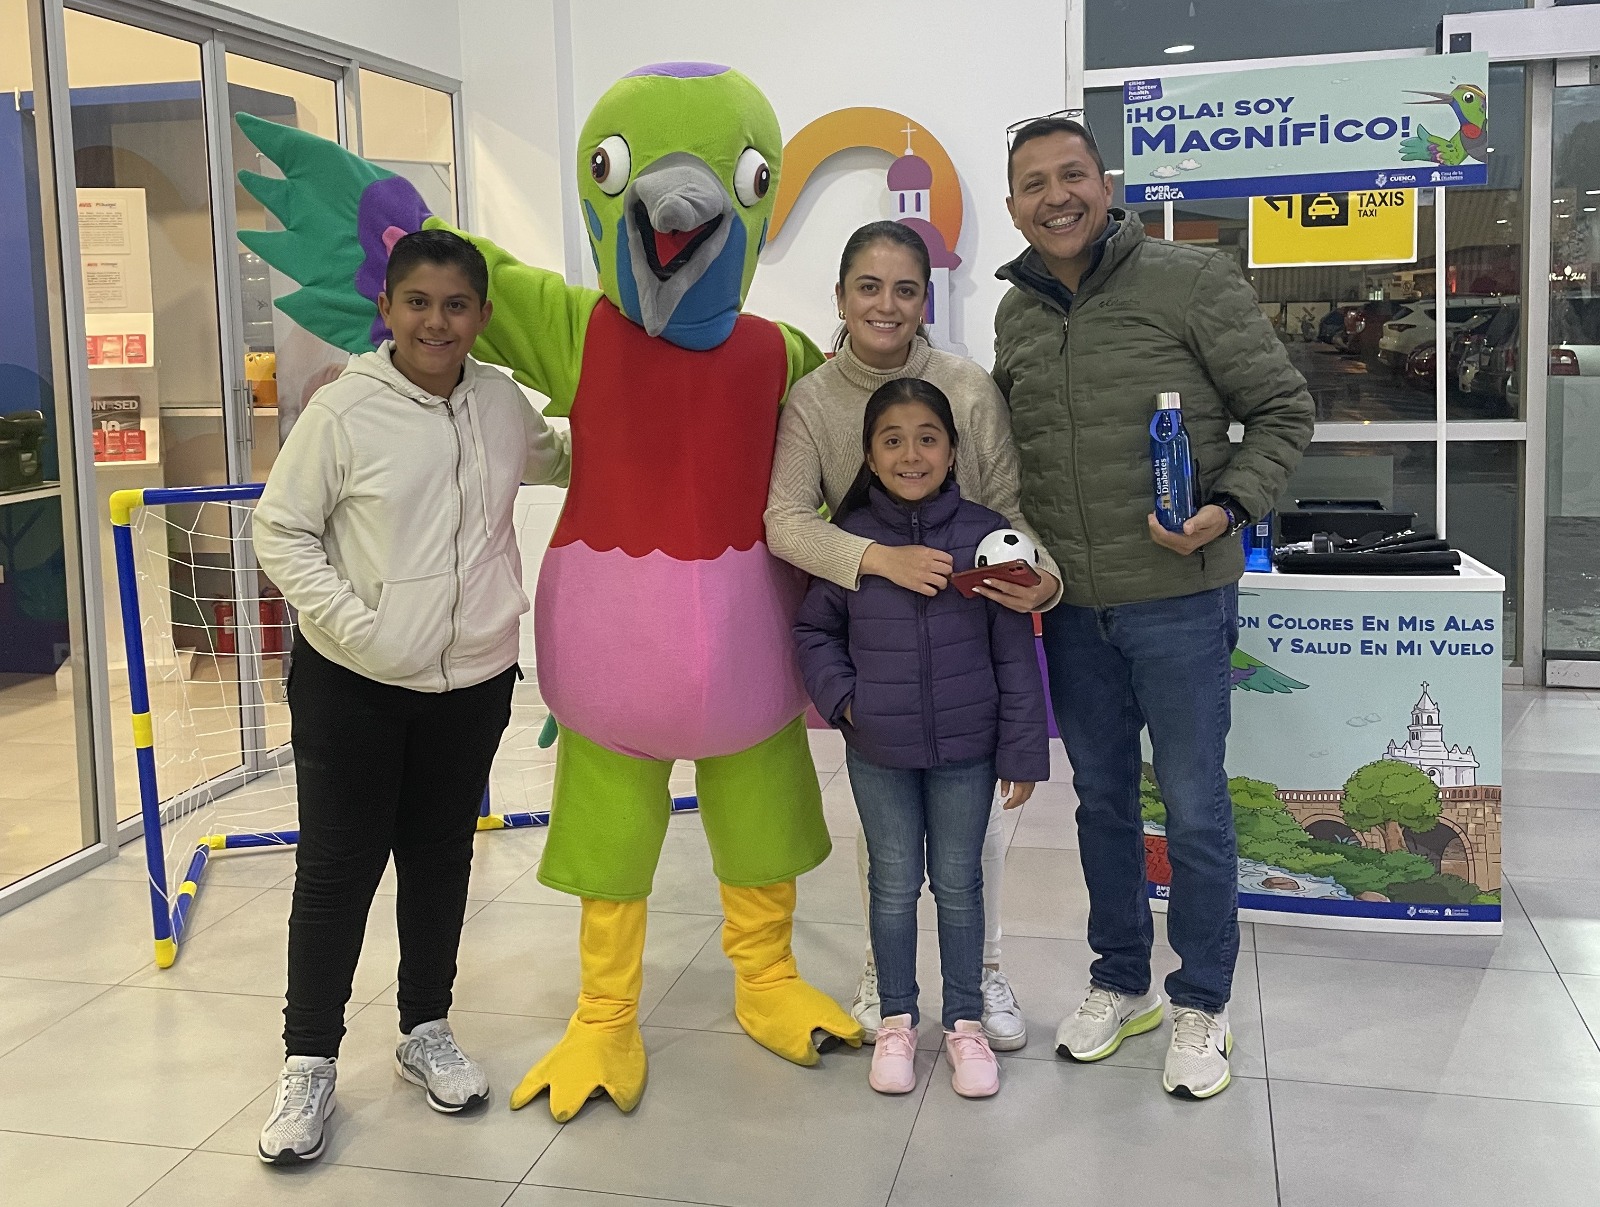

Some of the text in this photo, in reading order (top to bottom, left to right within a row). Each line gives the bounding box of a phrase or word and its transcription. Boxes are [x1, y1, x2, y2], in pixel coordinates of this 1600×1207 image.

[1126, 96, 1295, 124] ¡HOLA! SOY
[1145, 191, 1185, 200] CUENCA
[1356, 191, 1404, 207] TAXIS
[1358, 209, 1377, 218] TAXI
[1161, 458, 1169, 494] Diabetes
[1238, 613, 1495, 632] ON COLORES EN MIS ALAS
[1267, 637, 1495, 656] Y SALUD EN MI VUELO
[1156, 890, 1170, 898] CUE
